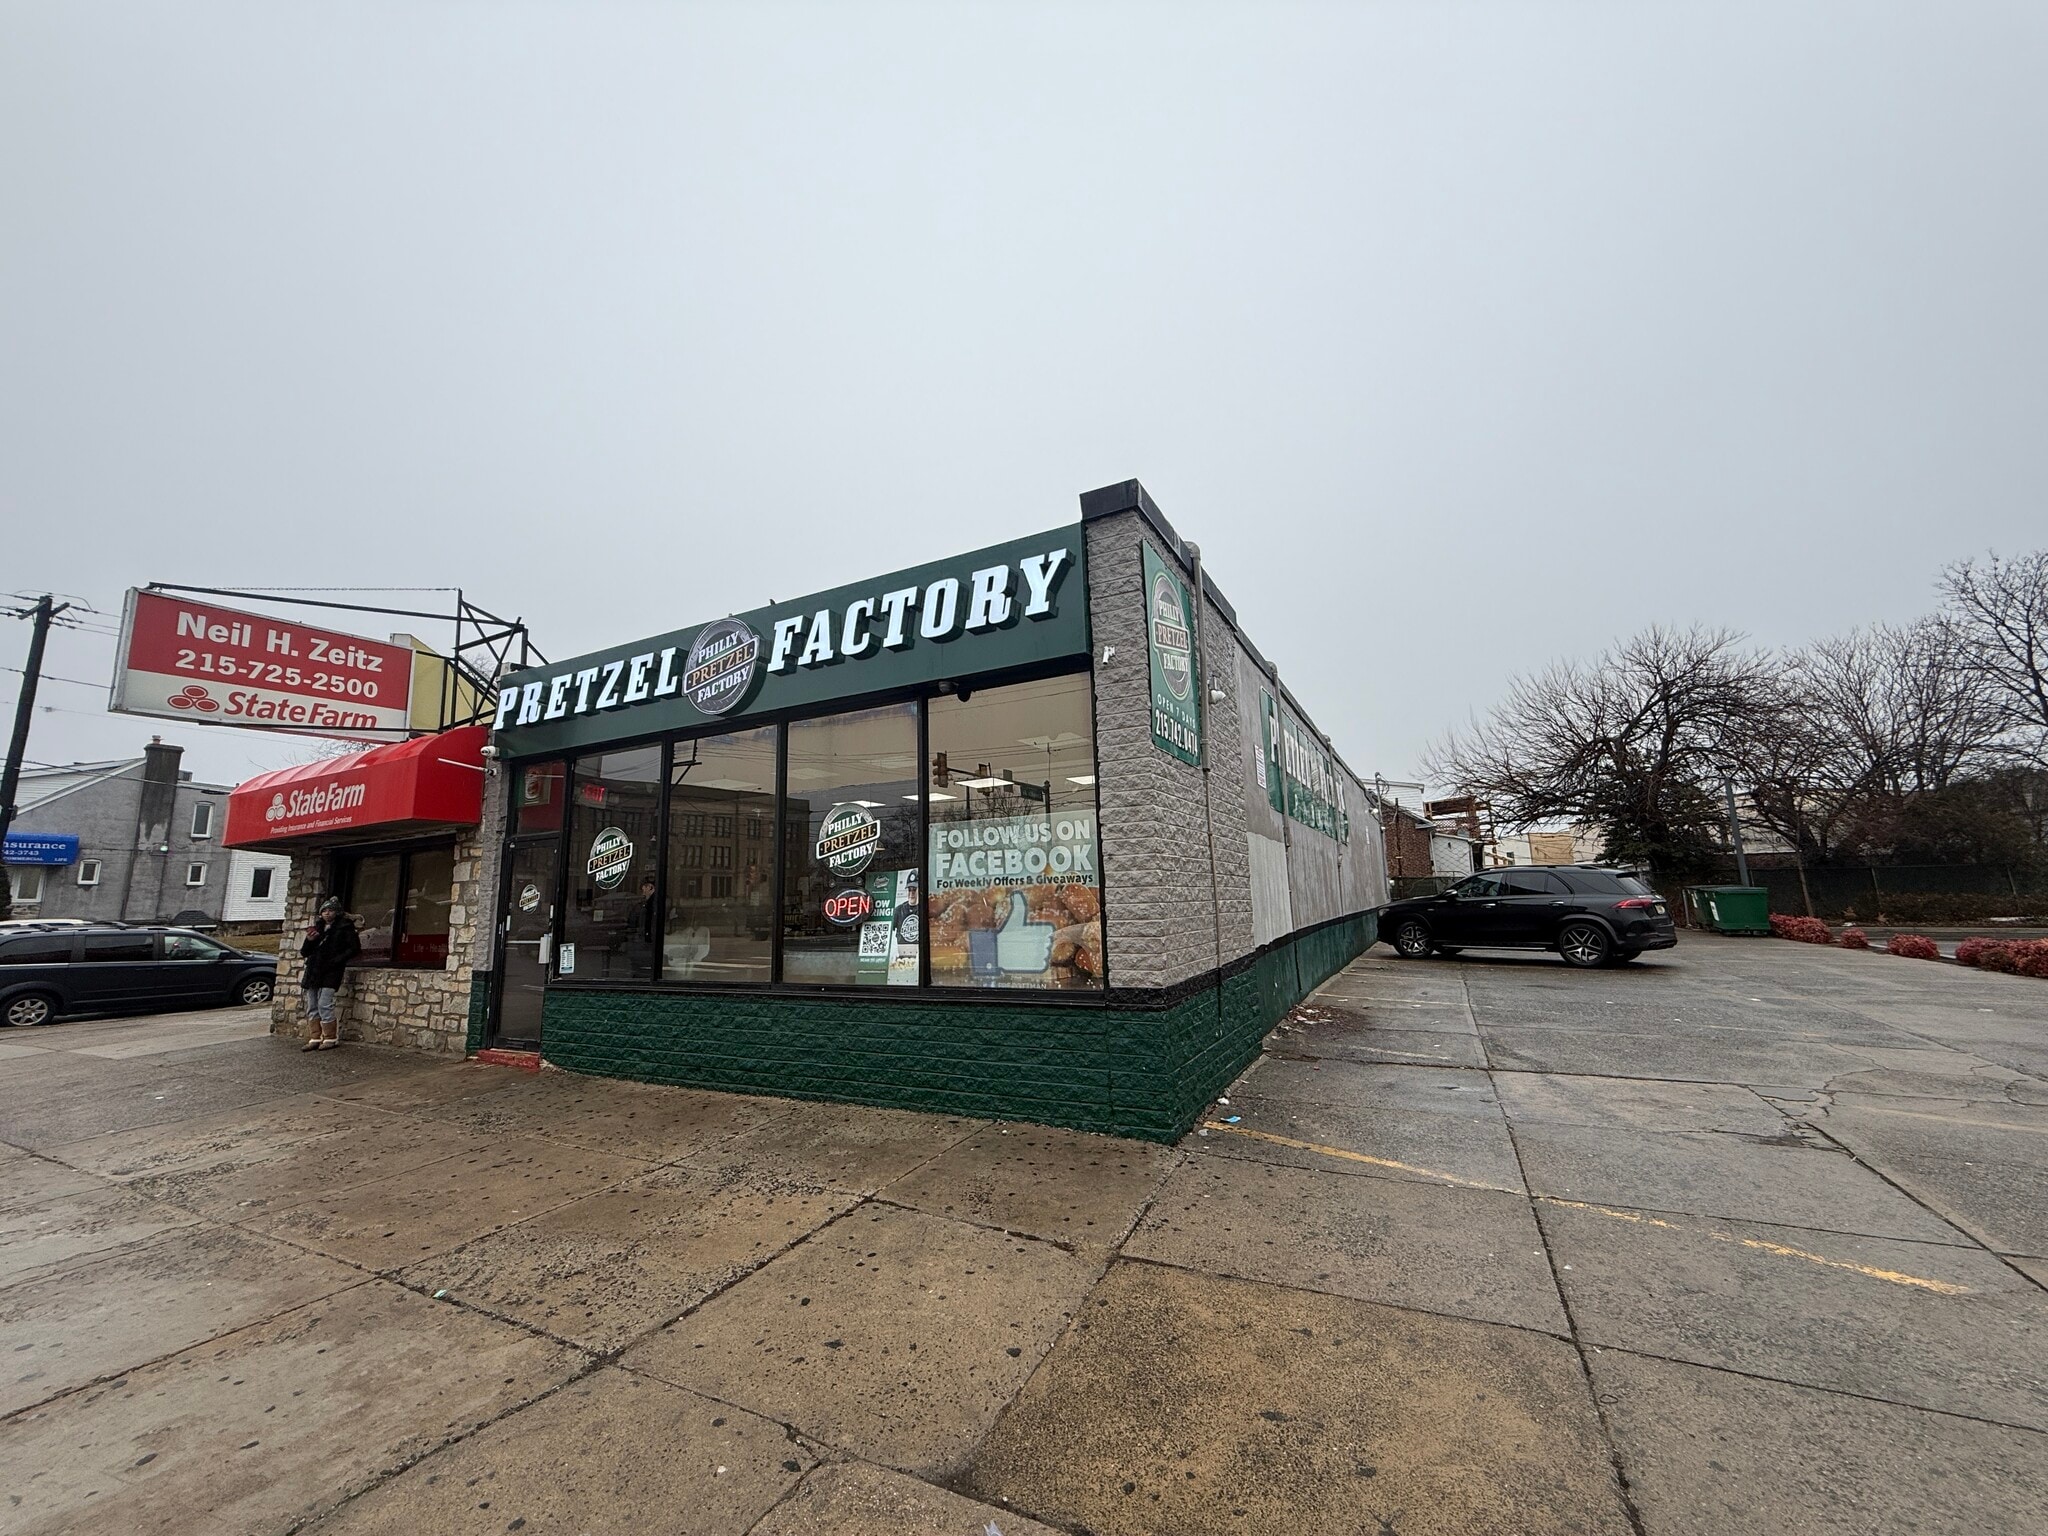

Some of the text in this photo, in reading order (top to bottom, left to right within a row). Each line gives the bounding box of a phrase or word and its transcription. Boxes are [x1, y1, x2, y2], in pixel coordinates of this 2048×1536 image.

[767, 548, 1068, 674] FACTORY
[1160, 600, 1179, 621] PHILLY
[176, 611, 383, 673] Neil H. Zeitz
[698, 631, 740, 663] PHILLY
[1158, 624, 1188, 649] PRETZEL
[175, 649, 379, 698] 215-725-2500
[691, 645, 752, 687] PRETZEL
[1163, 653, 1189, 672] FACTORY
[492, 647, 678, 731] PRETZEL
[697, 665, 750, 703] FACTORY
[1157, 693, 1196, 729] OPEN 7 DAYS
[334, 816, 353, 825] Services
[828, 813, 863, 835] PHILLY
[2, 841, 67, 850] nsurance
[596, 836, 622, 855] PHILLY
[823, 825, 875, 853] PRETZEL
[936, 819, 1091, 849] FOLLOW US ON
[592, 847, 629, 870] PRETZEL
[829, 842, 874, 868] FACTORY
[935, 843, 1093, 878] FACEBOOK
[595, 861, 628, 882] FACTORY
[936, 879, 954, 889] For
[955, 877, 992, 889] Weekly
[993, 875, 1026, 886] Offers
[1036, 873, 1094, 885] Giveaways
[825, 895, 870, 918] OPEN
[874, 899, 890, 908] OW
